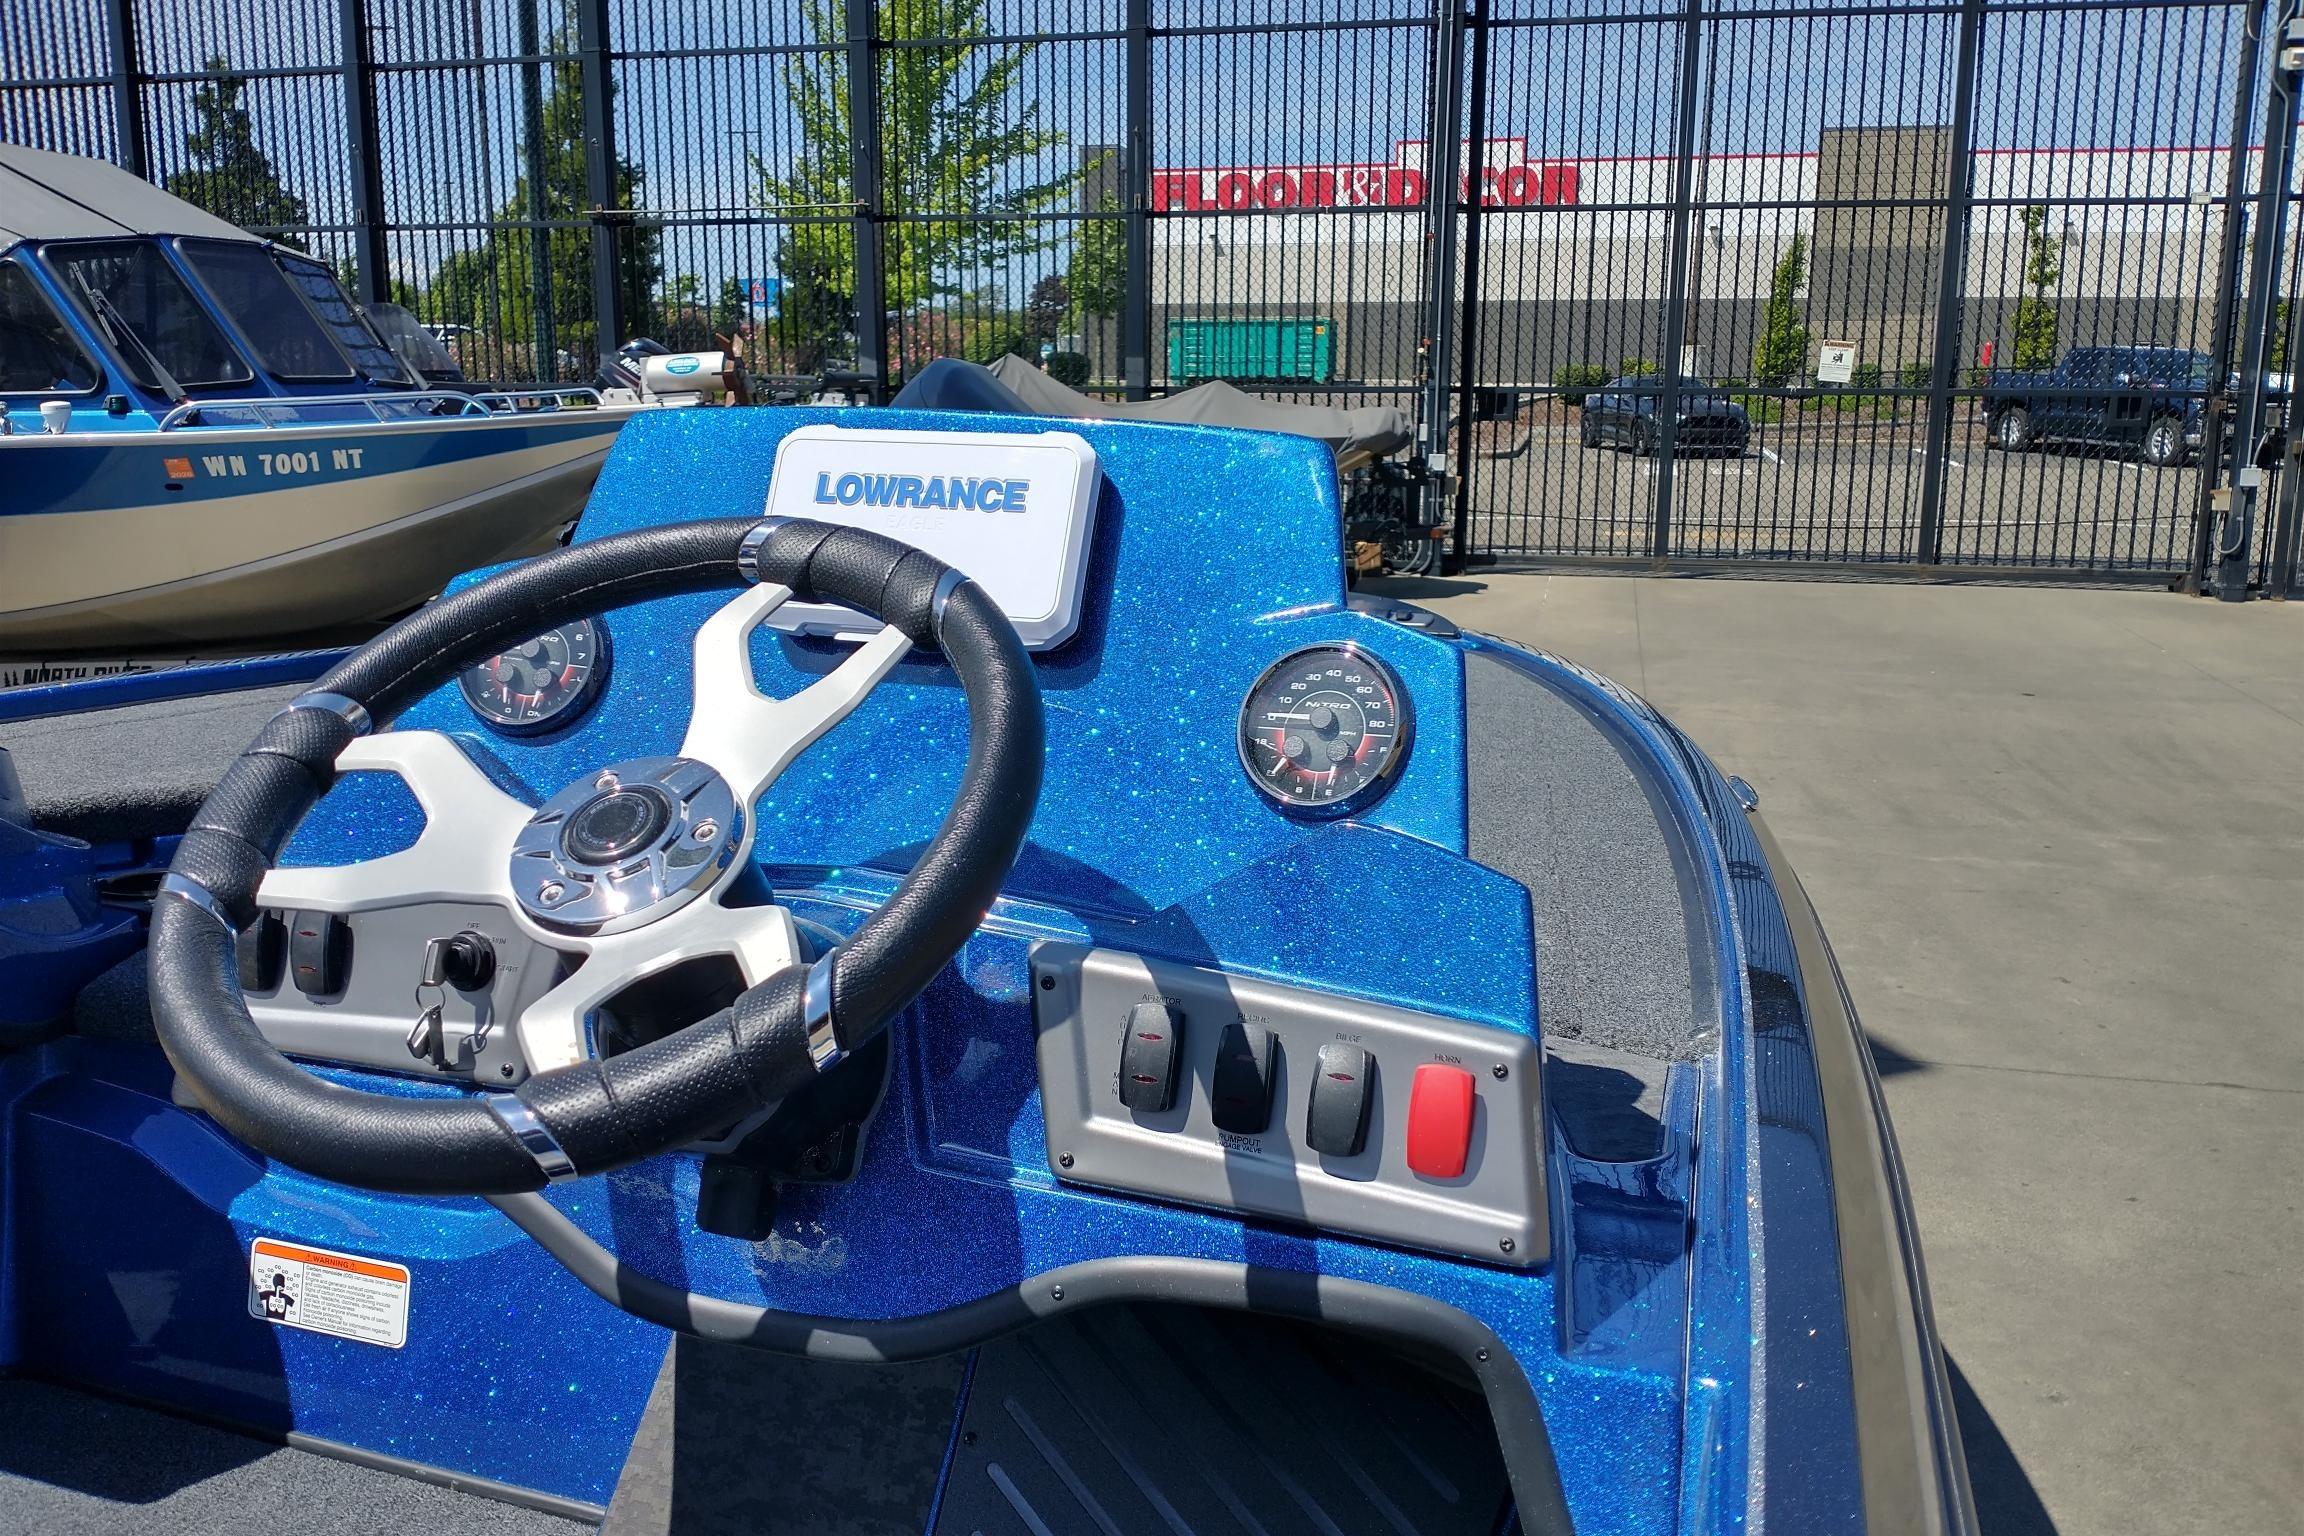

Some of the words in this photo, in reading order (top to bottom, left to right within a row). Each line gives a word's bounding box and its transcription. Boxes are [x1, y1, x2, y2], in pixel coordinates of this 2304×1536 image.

[202, 456, 248, 477] WN
[258, 451, 320, 476] 7001
[332, 448, 364, 470] NT
[815, 471, 1030, 513] LOWRANCE
[886, 514, 945, 531] EAGLE
[1335, 1032, 1361, 1043] BILGE
[1434, 1053, 1461, 1064] HORN
[1218, 1132, 1261, 1147] PUMPOUT
[1242, 1145, 1262, 1154] VALVE
[312, 1255, 349, 1268] WARNING
